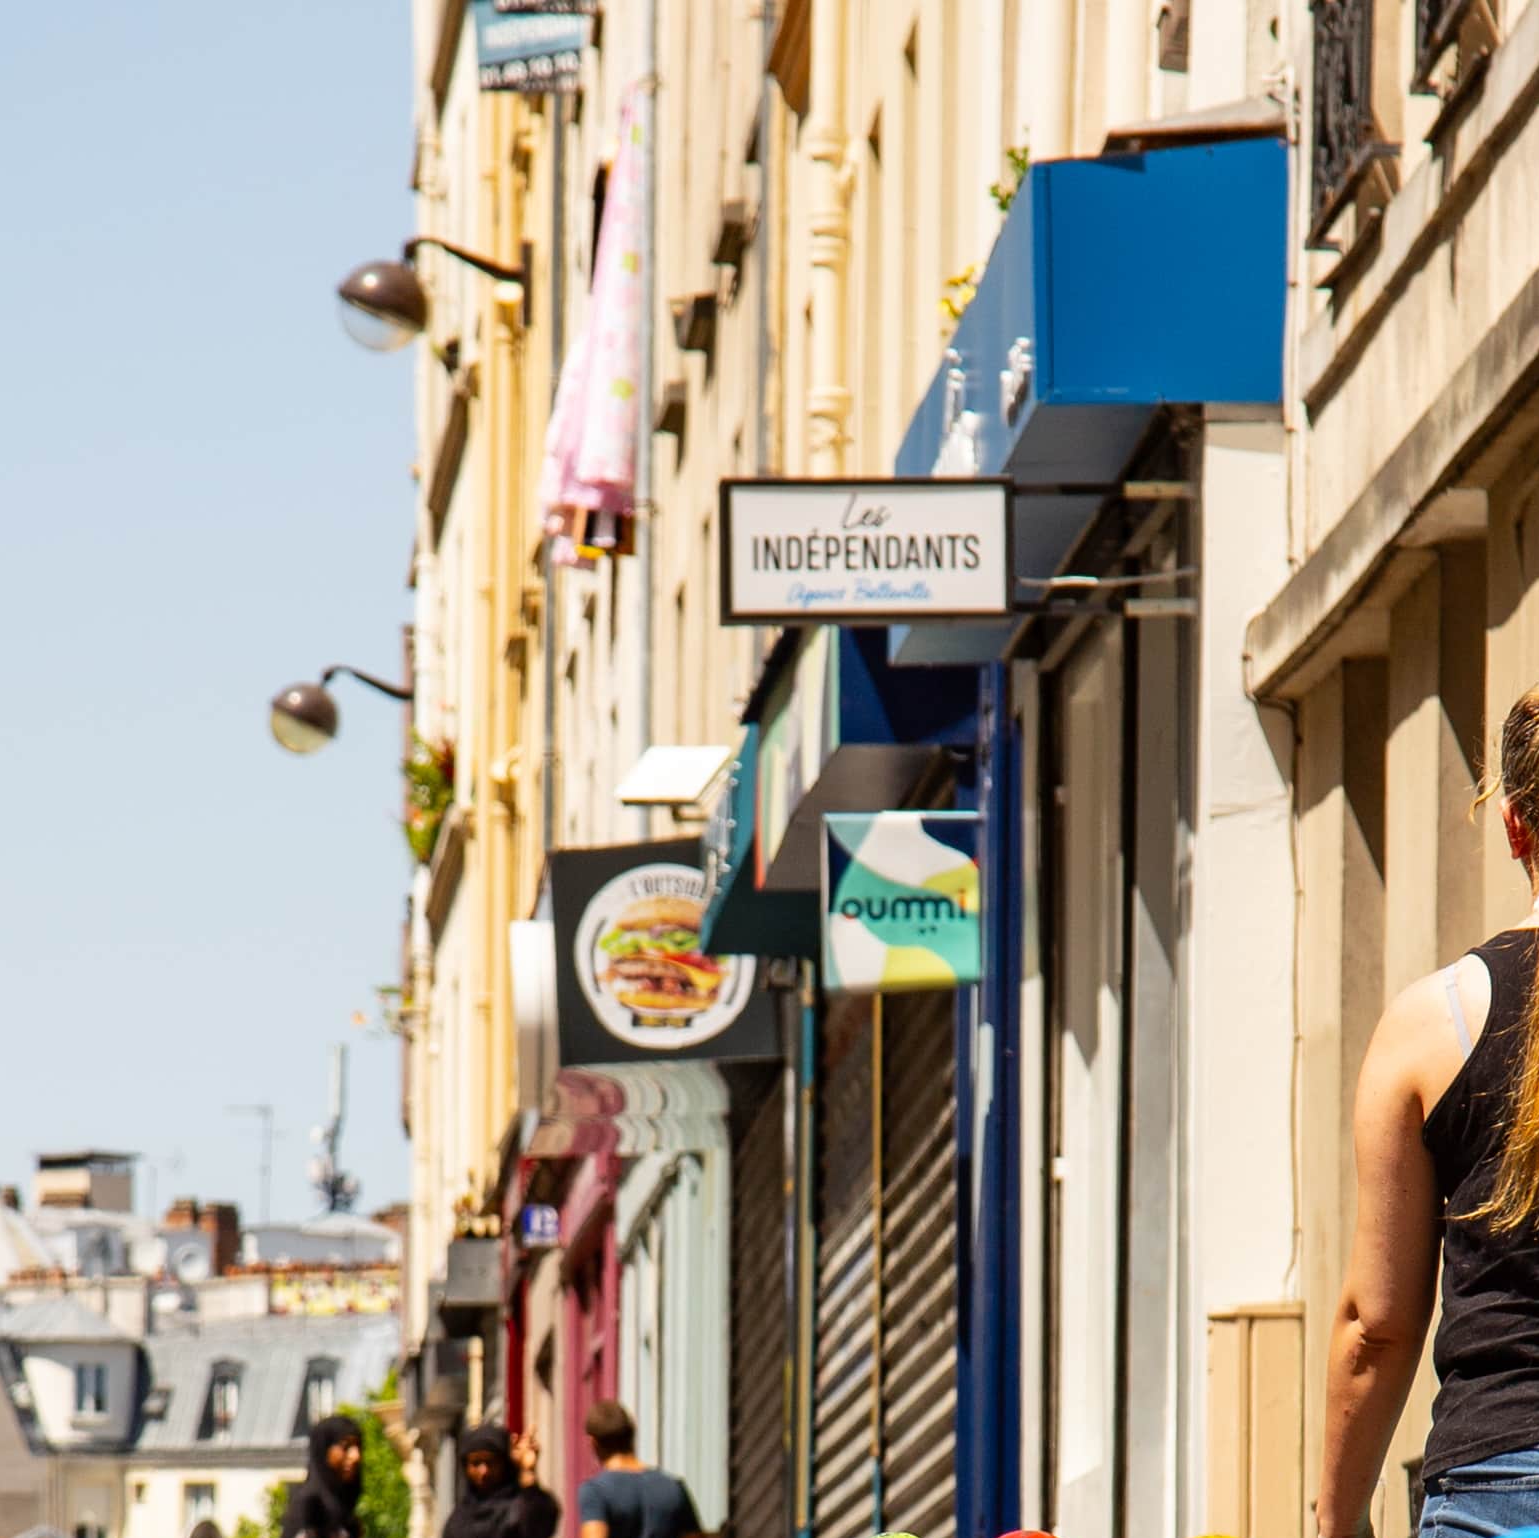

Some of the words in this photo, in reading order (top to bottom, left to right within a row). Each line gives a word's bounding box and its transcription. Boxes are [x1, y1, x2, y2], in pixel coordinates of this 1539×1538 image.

[842, 492, 891, 529] Les
[752, 528, 981, 571] INDÉPENDANTS
[842, 888, 967, 920] oummi
